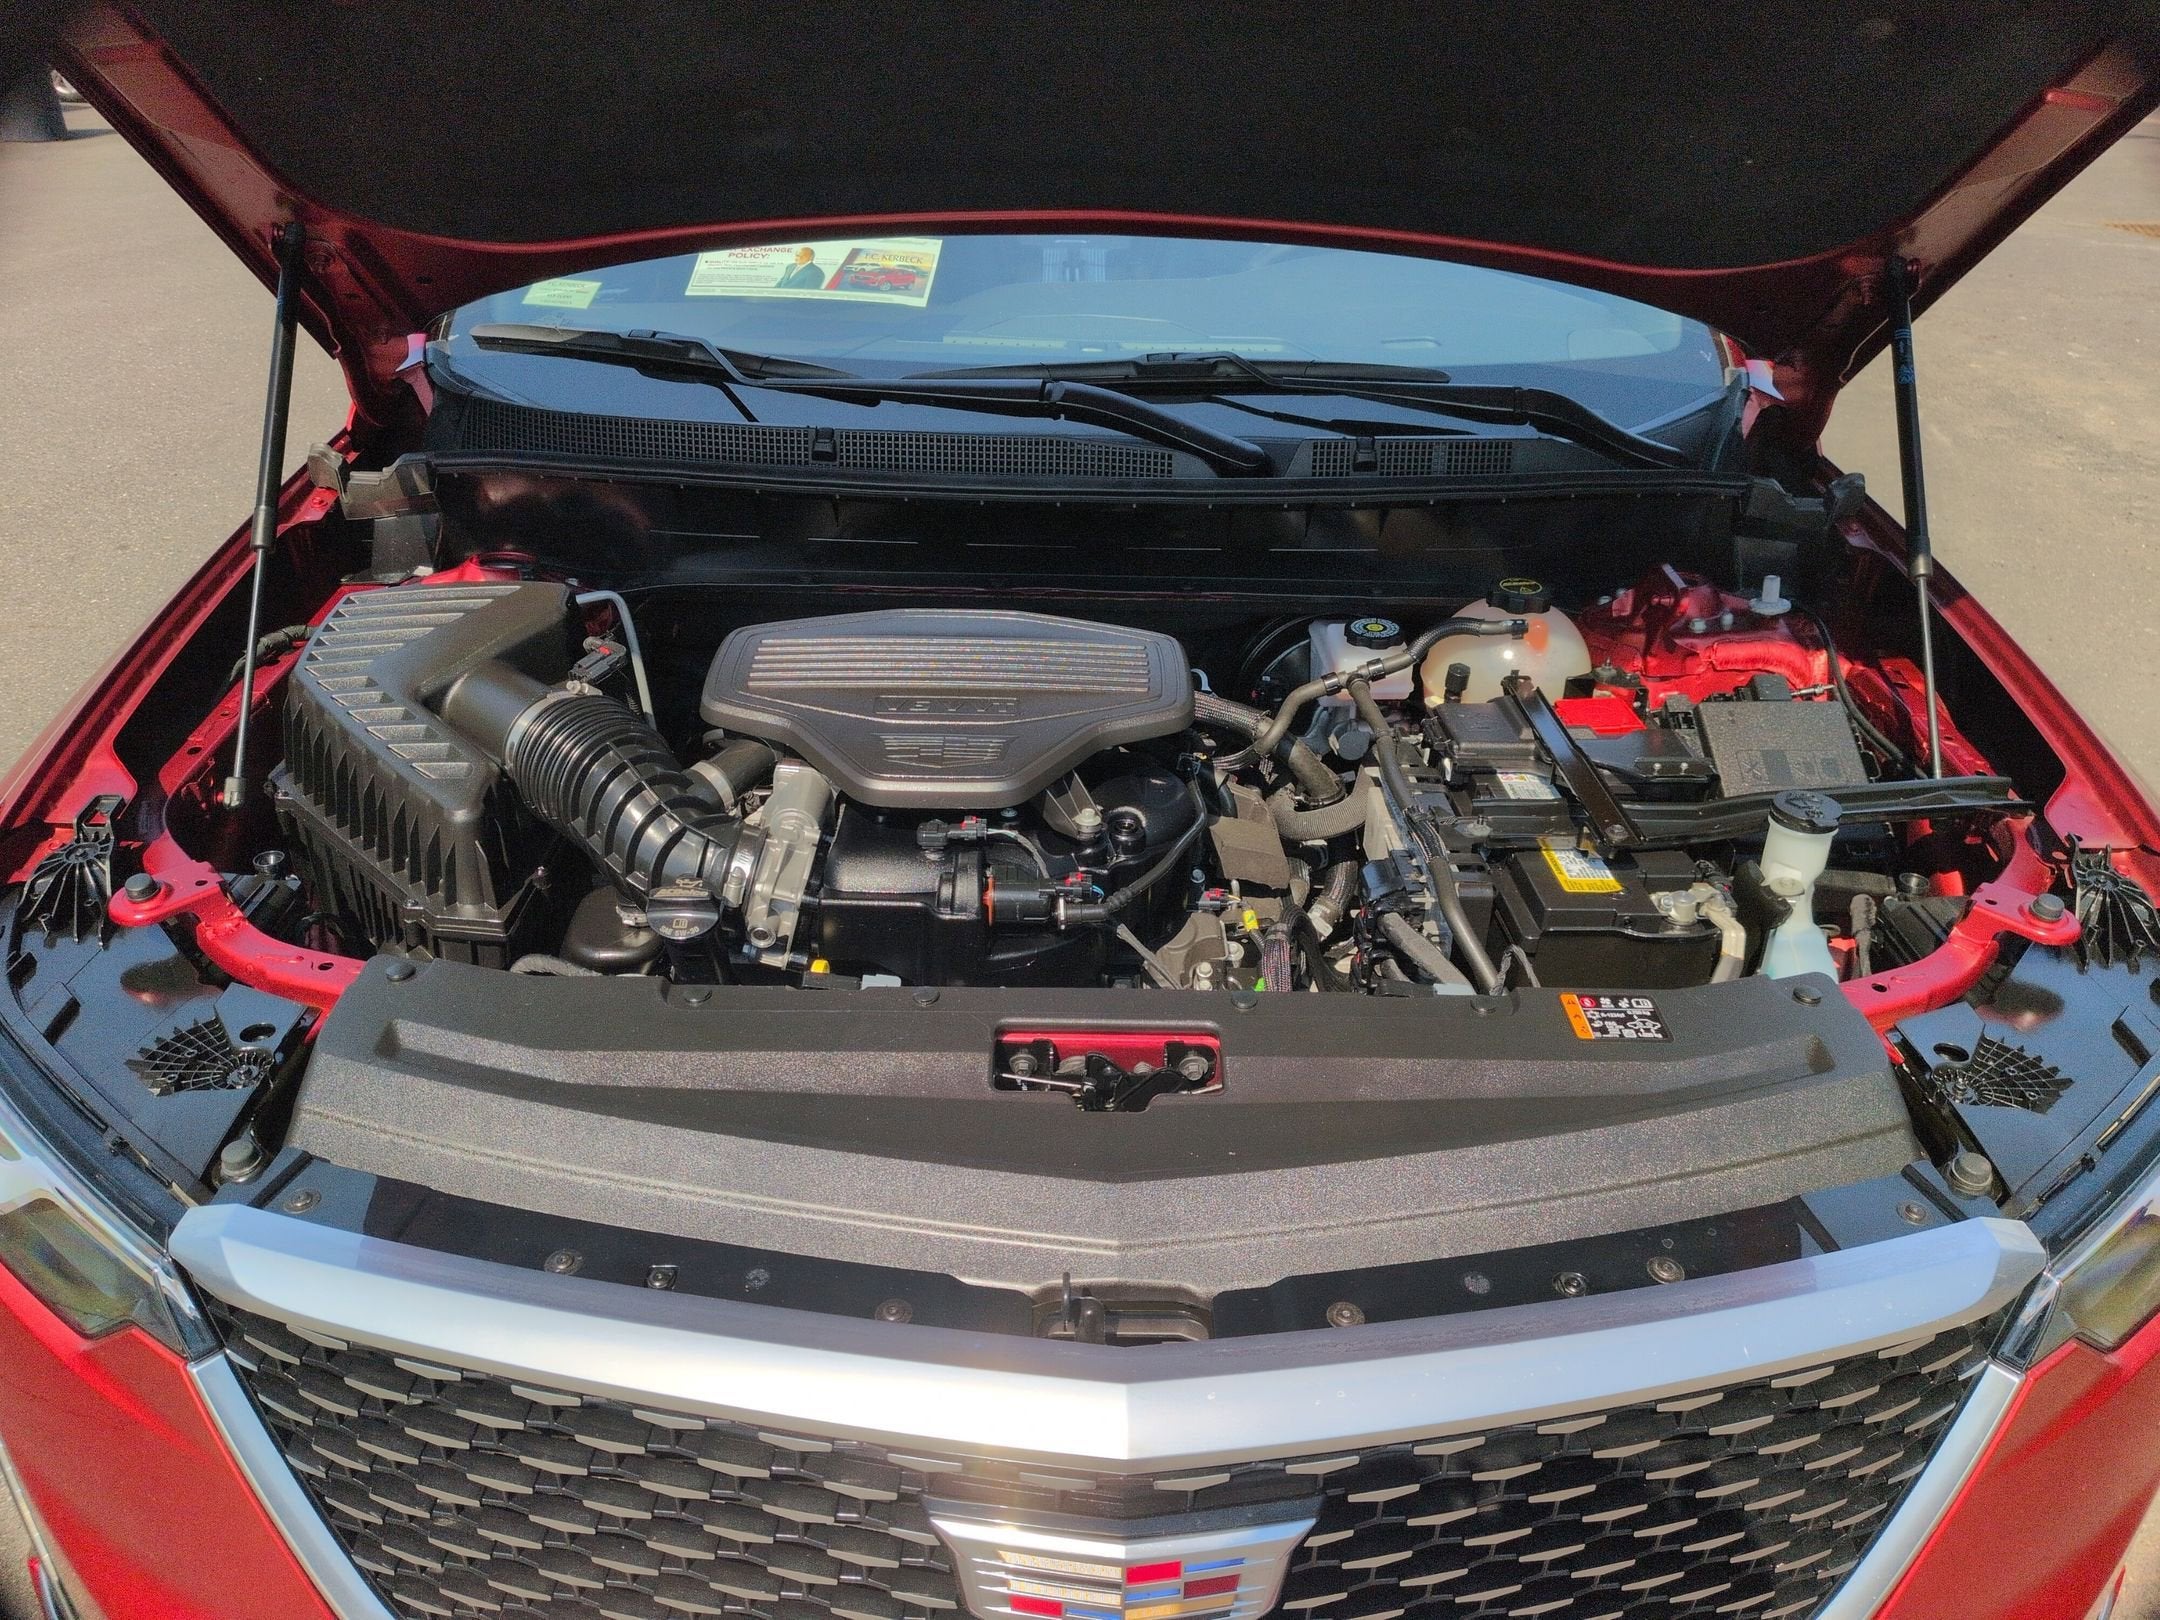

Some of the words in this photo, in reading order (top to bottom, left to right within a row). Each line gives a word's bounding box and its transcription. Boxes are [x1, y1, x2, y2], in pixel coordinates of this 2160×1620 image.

[881, 253, 924, 264] KERBECK
[659, 925, 673, 935] SAE
[674, 926, 700, 937] 5W-30
